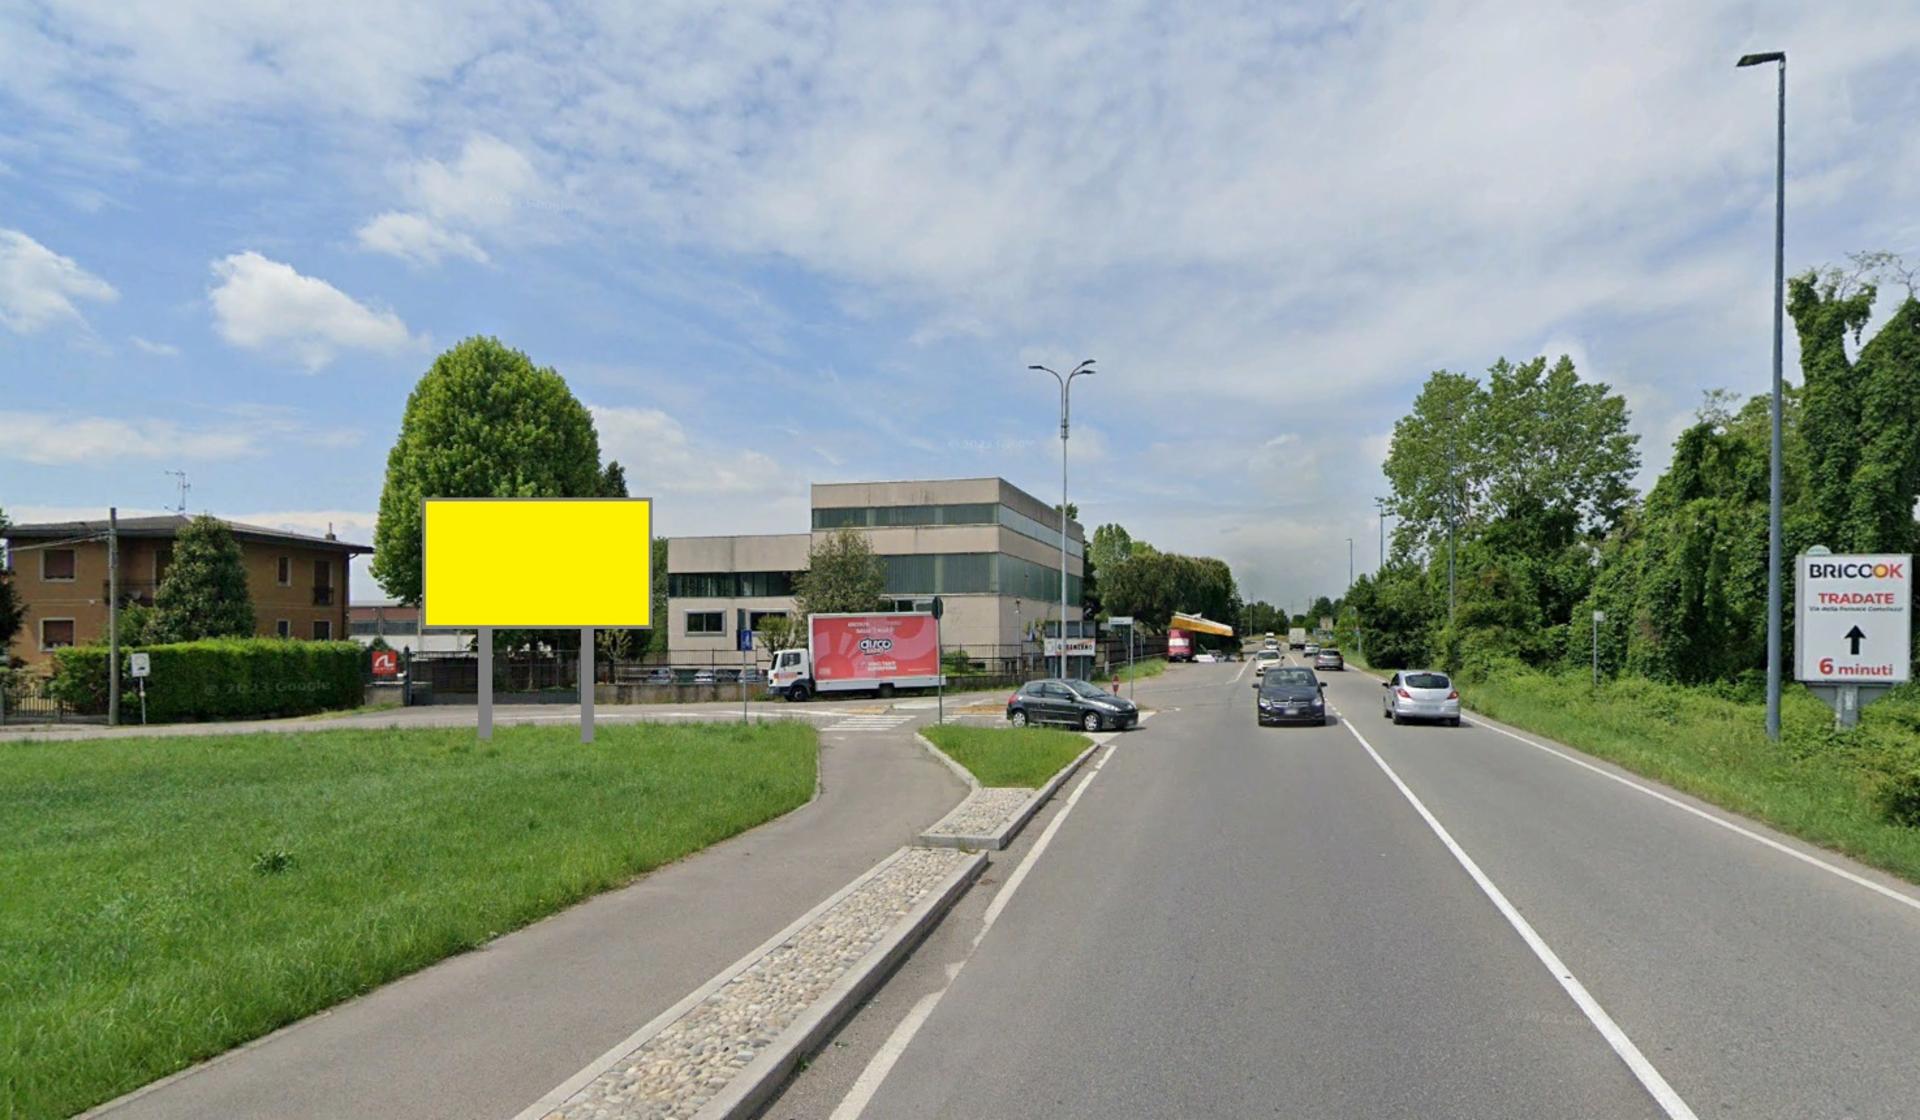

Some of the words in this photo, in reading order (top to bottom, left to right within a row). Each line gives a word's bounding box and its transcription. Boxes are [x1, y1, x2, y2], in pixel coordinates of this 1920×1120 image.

[1818, 593, 1895, 604] TRADATE
[1819, 658, 1834, 675] 6
[1838, 664, 1893, 675] minuti
